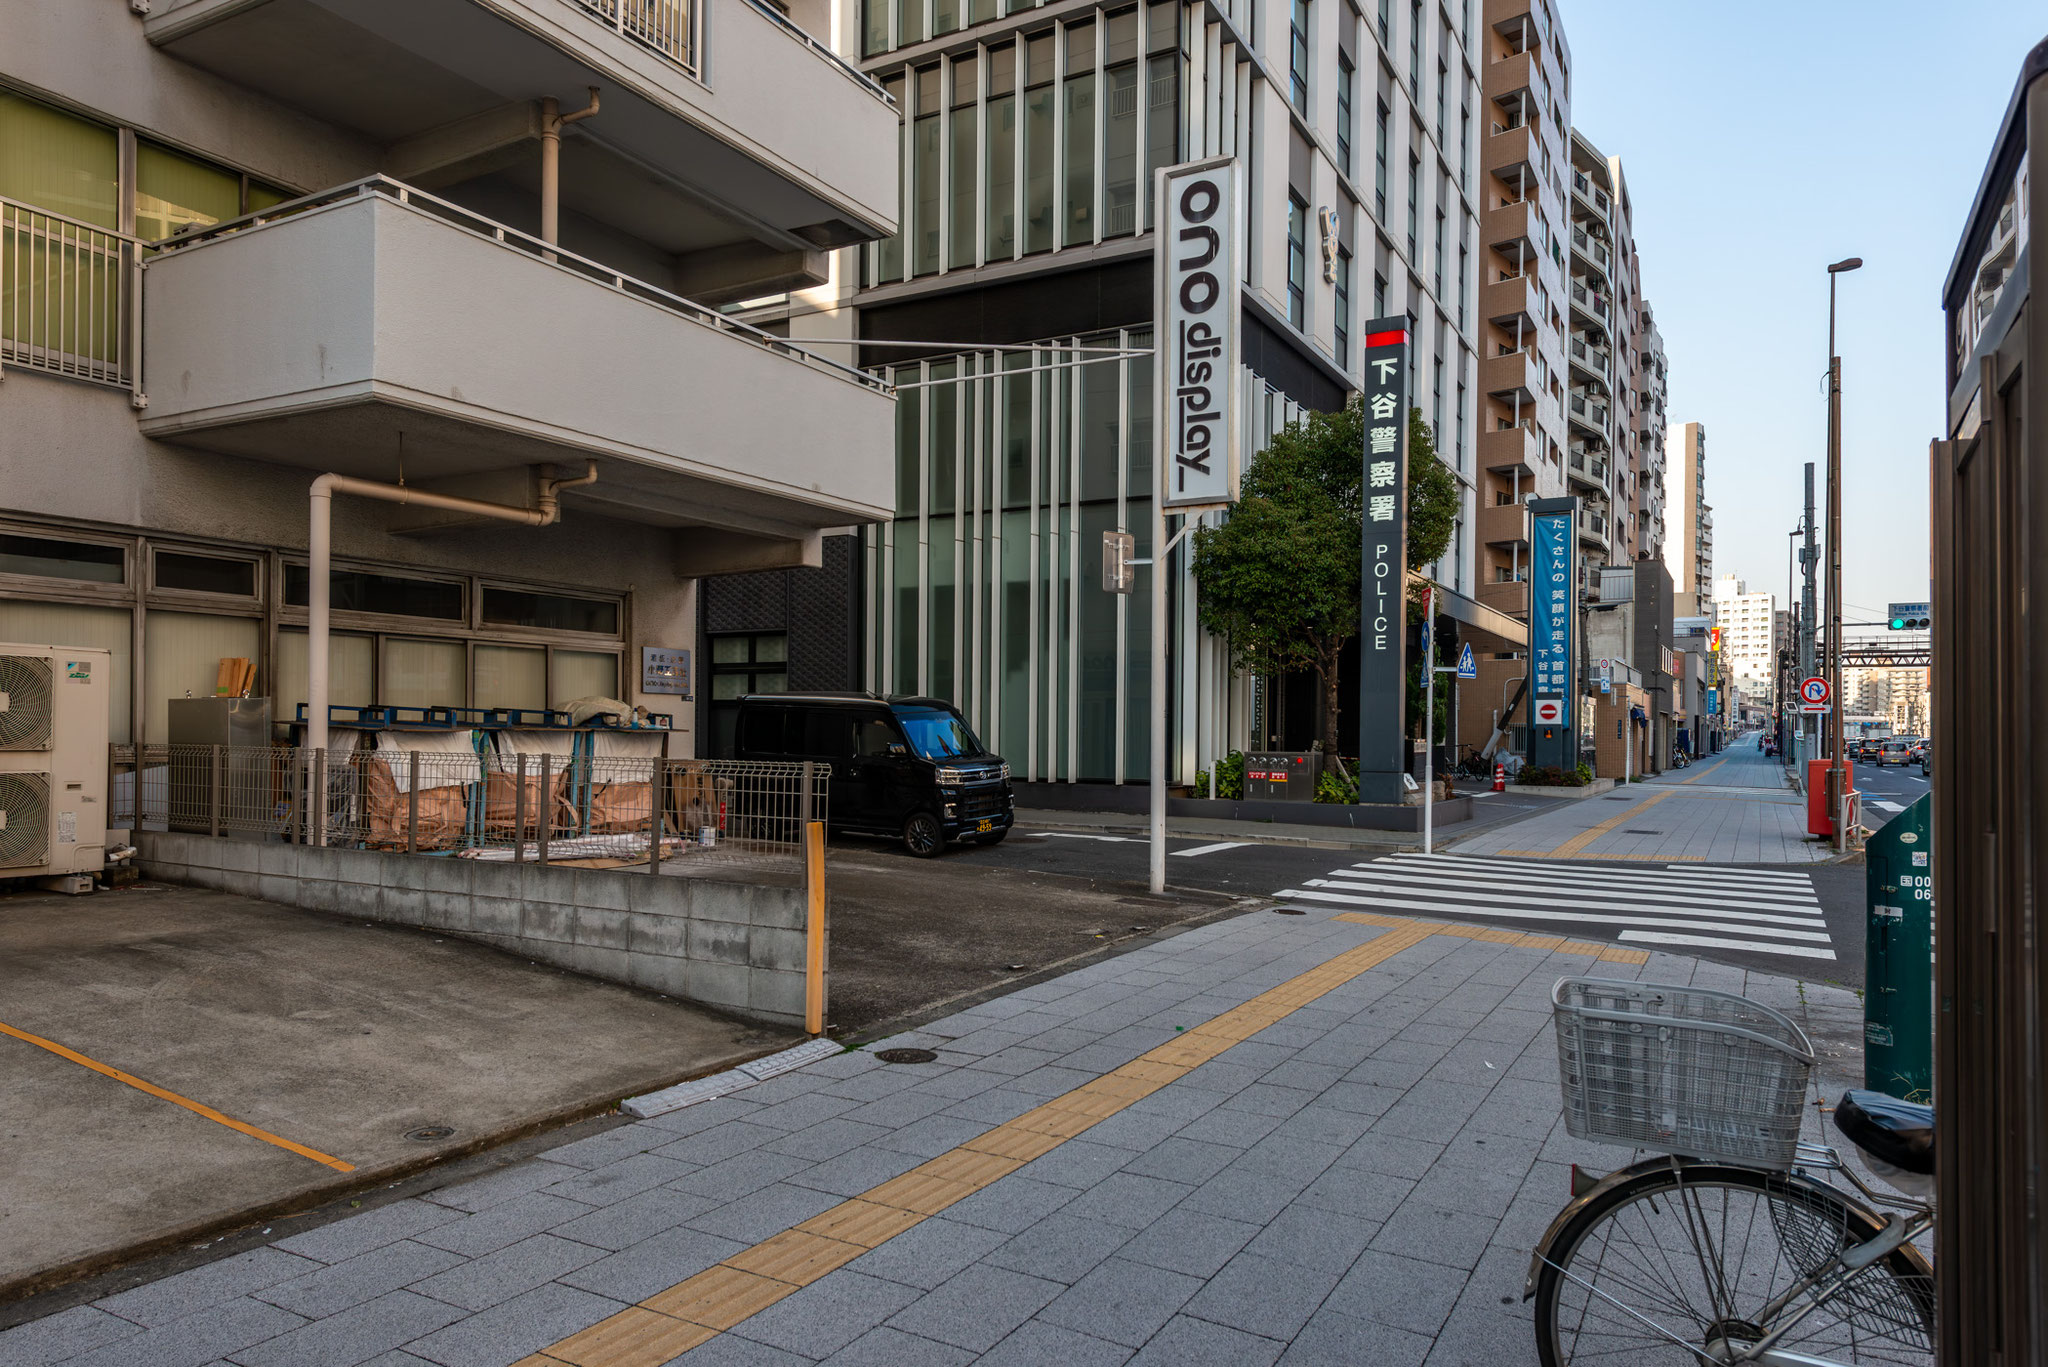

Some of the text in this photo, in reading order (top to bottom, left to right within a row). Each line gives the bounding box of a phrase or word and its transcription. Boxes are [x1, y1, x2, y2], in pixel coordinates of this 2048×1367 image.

[1176, 180, 1222, 476] ono display
[1369, 357, 1398, 522] 下谷警察署
[1552, 519, 1565, 582] たくさんの
[1374, 544, 1389, 650] POLICE
[1552, 590, 1565, 654] 笑顔が走る
[1914, 889, 1931, 900] 06
[1915, 876, 1931, 888] 00
